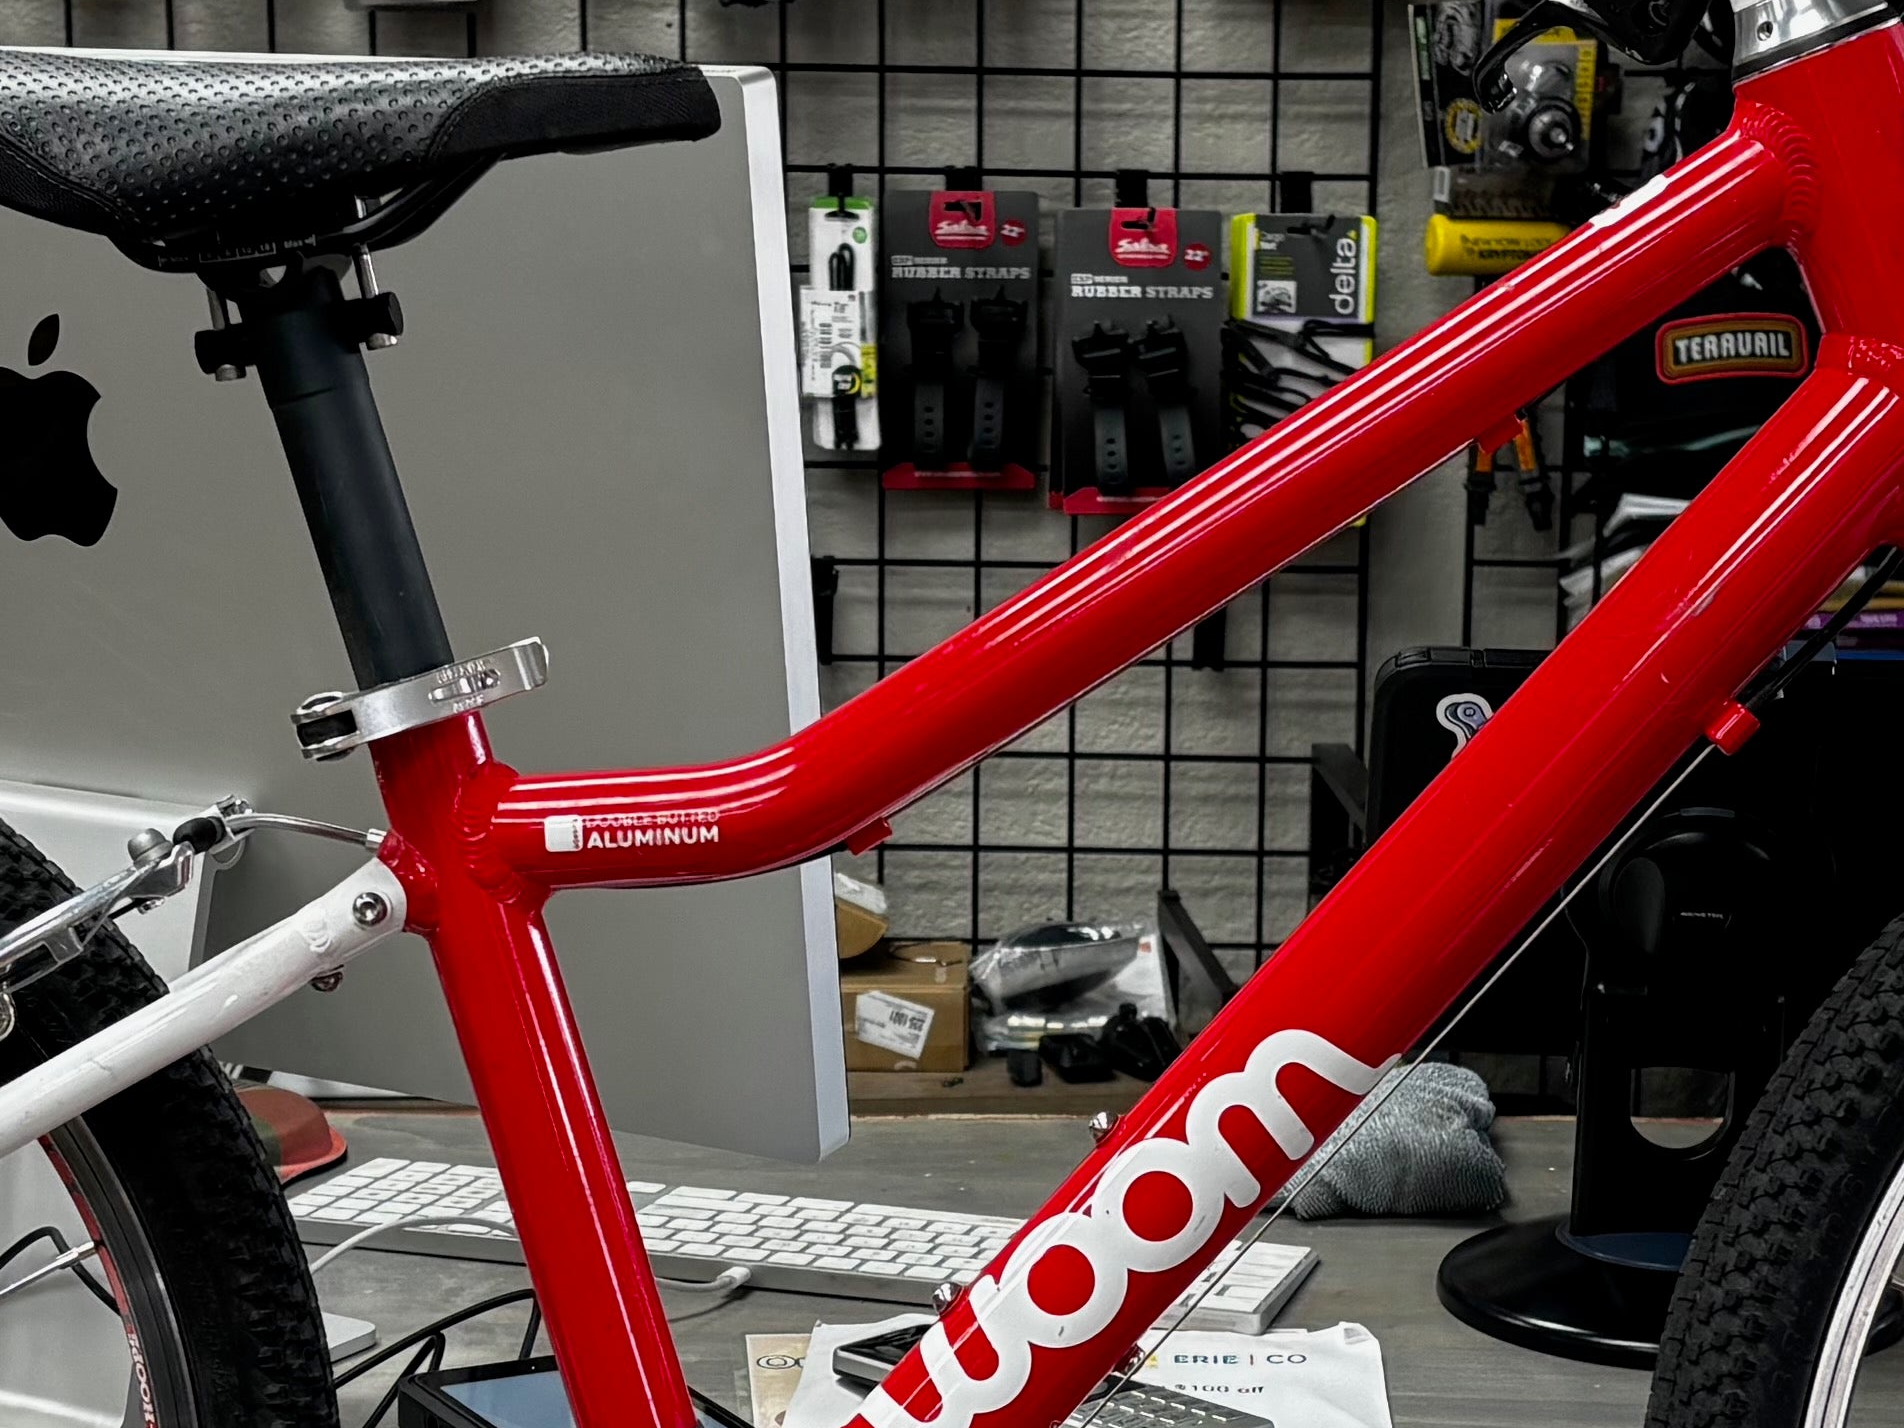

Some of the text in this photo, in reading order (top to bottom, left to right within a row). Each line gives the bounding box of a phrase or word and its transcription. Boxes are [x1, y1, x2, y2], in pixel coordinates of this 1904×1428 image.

[892, 266, 1031, 280] RUBBER STRAPS
[1329, 238, 1356, 315] delta
[1071, 285, 1214, 300] RUBBER STRAPS
[585, 824, 721, 850] ALUMINUM
[1173, 1353, 1307, 1365] ERIE CO
